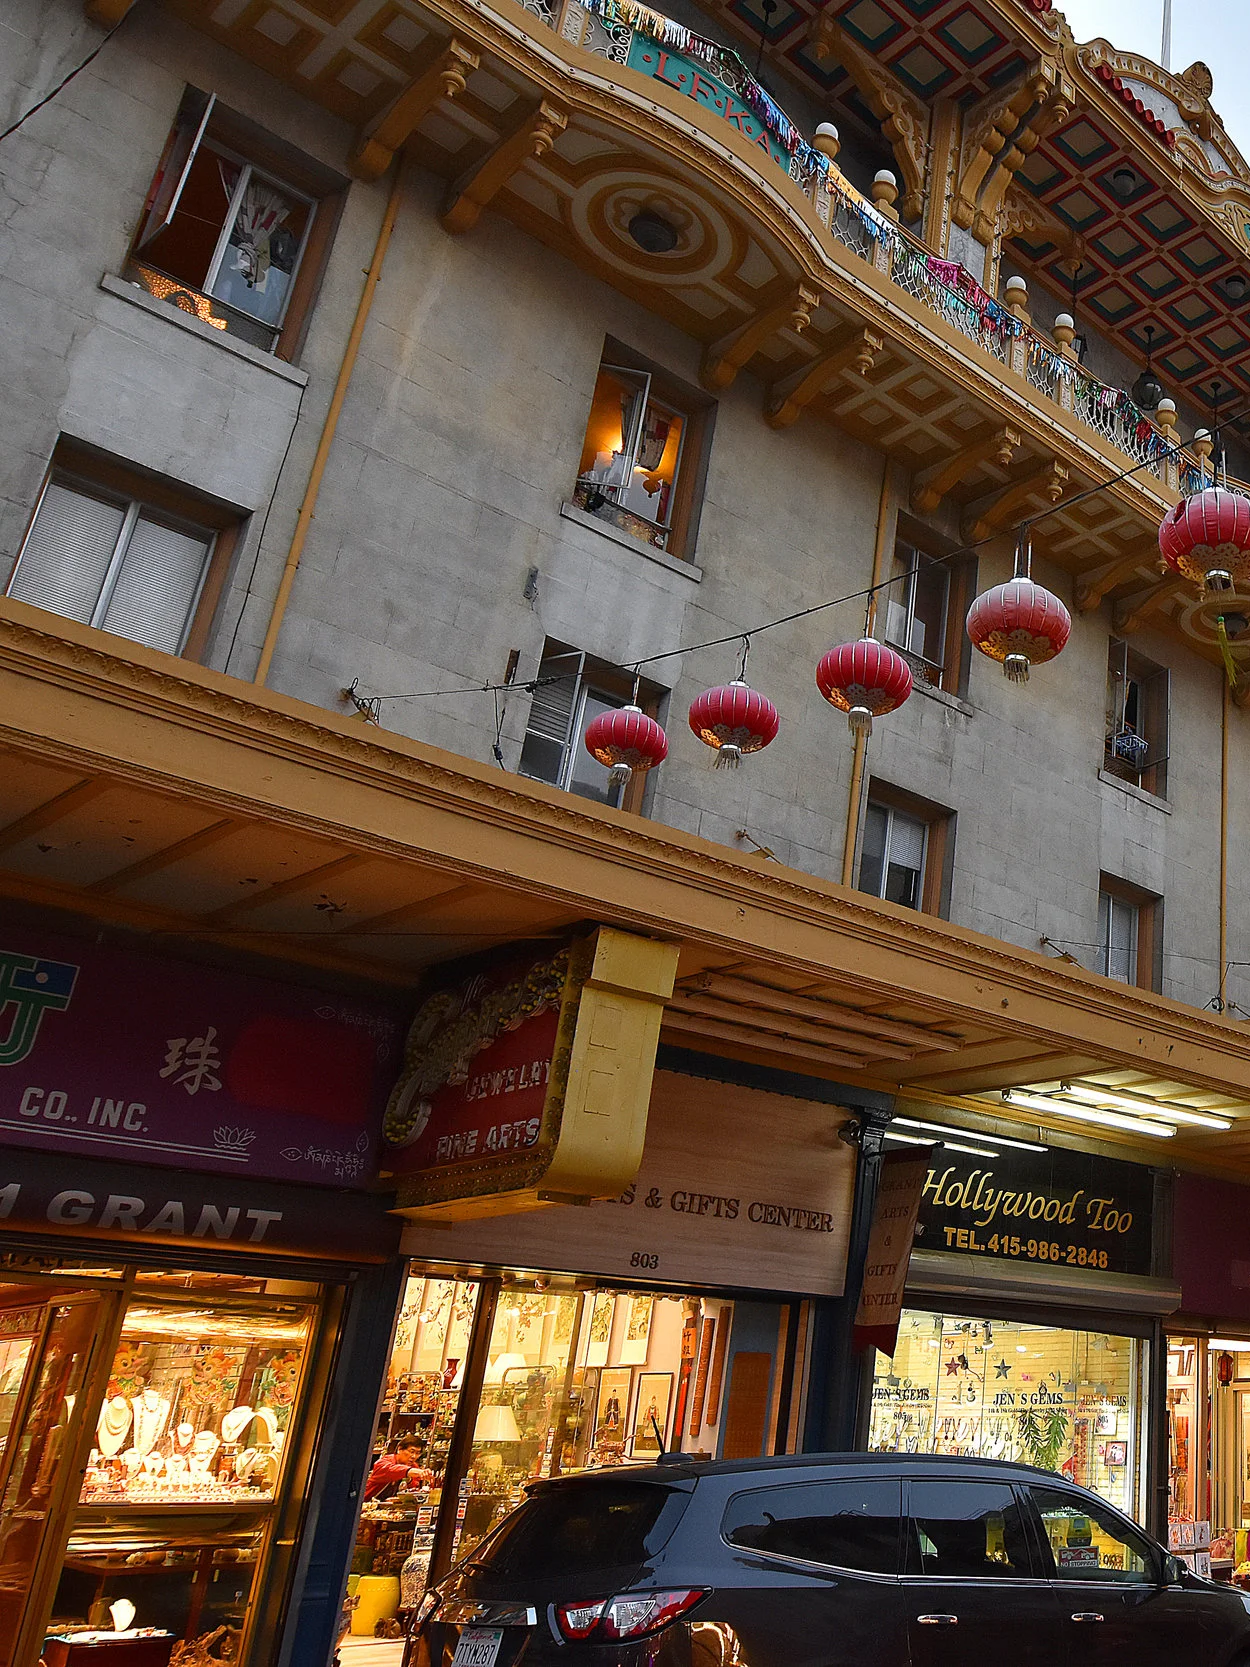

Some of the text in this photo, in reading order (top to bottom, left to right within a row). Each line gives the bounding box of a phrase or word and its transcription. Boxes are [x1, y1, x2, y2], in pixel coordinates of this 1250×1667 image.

[159, 1025, 223, 1096] 珠
[88, 1096, 149, 1133] INC.
[482, 1117, 541, 1154] ARTS
[46, 1189, 283, 1242] GRANT
[645, 1187, 662, 1209] &
[671, 1190, 740, 1220] GIFTS
[748, 1202, 834, 1233] CENTER
[882, 1206, 909, 1219] ARTS
[921, 1166, 1133, 1234] Hollywood Too
[884, 1235, 892, 1246] &
[630, 1252, 658, 1270] 803
[867, 1263, 898, 1277] GIFTS
[1030, 1392, 1063, 1405] GEMS
